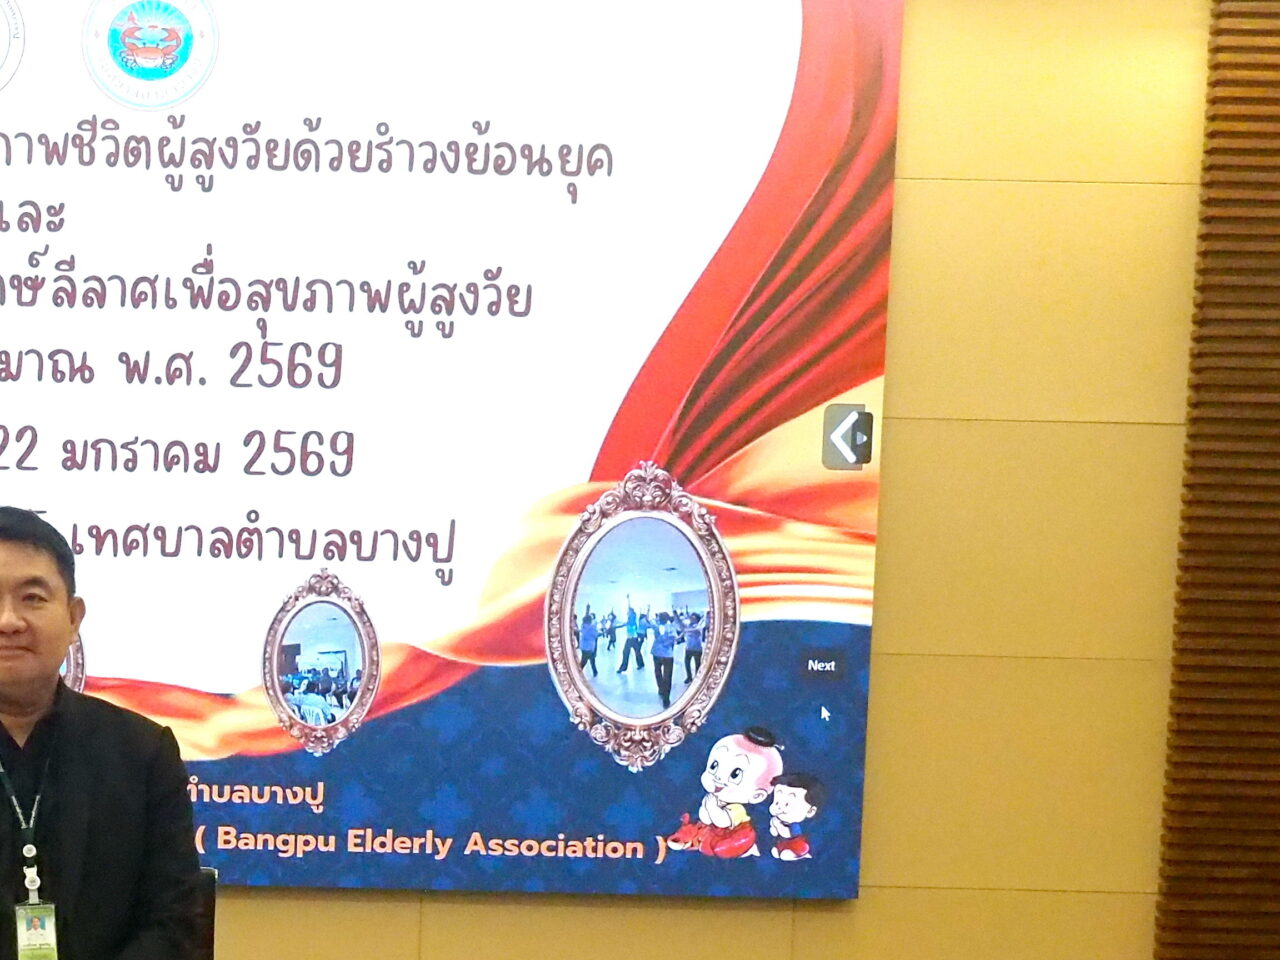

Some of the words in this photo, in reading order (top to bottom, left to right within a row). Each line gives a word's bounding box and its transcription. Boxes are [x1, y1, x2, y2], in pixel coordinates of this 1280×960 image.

[118, 350, 207, 387] พ.ศ.
[229, 341, 343, 390] 2569
[61, 436, 221, 474] มกราคม
[243, 429, 355, 477] 2569
[72, 510, 456, 587] เทศบาลตำบลบางปู
[807, 659, 837, 672] Next
[186, 775, 325, 814] ำบลบางปู
[217, 826, 336, 858] Bangpu
[347, 828, 453, 861] Elderly
[463, 831, 645, 860] Association
